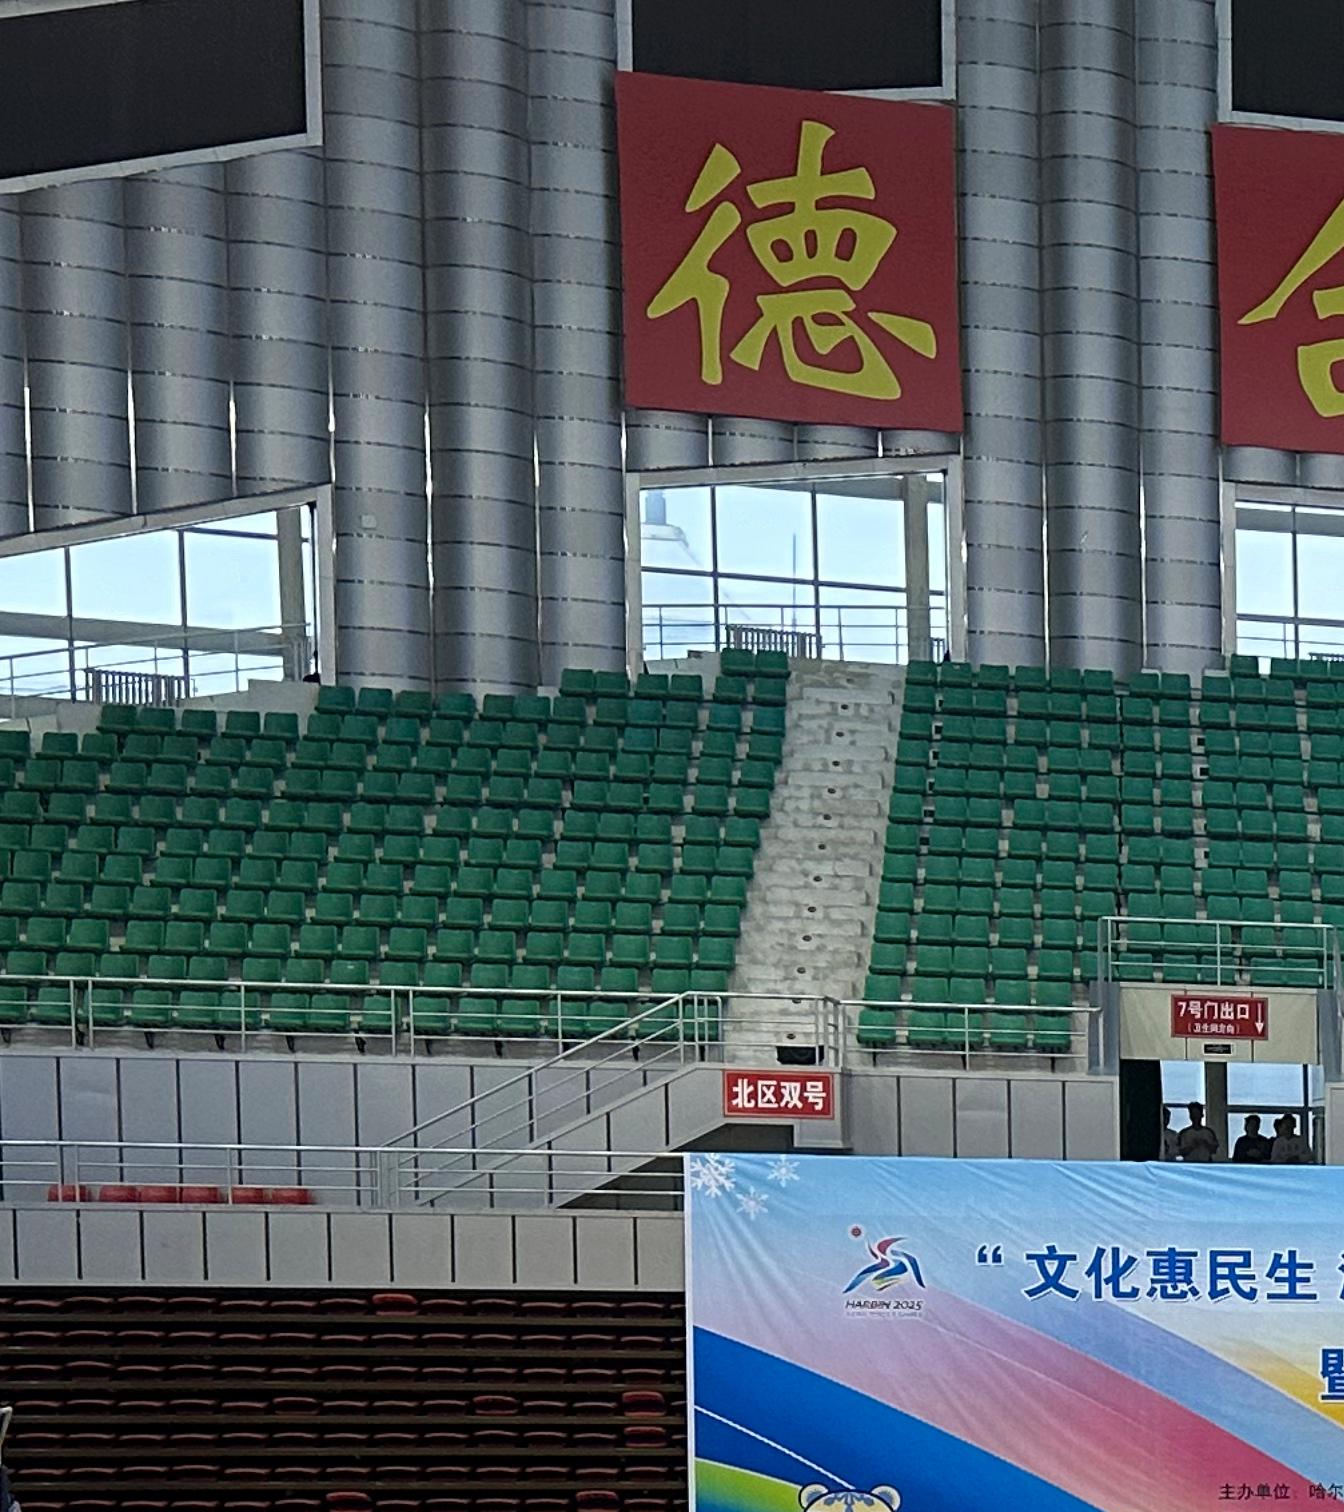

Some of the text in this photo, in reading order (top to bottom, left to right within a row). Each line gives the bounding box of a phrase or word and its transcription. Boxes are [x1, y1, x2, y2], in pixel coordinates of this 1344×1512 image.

[645, 119, 937, 401] 德
[1177, 1001, 1250, 1020] 7号门出口
[732, 1078, 827, 1110] 北区双号
[892, 1299, 923, 1311] 2025
